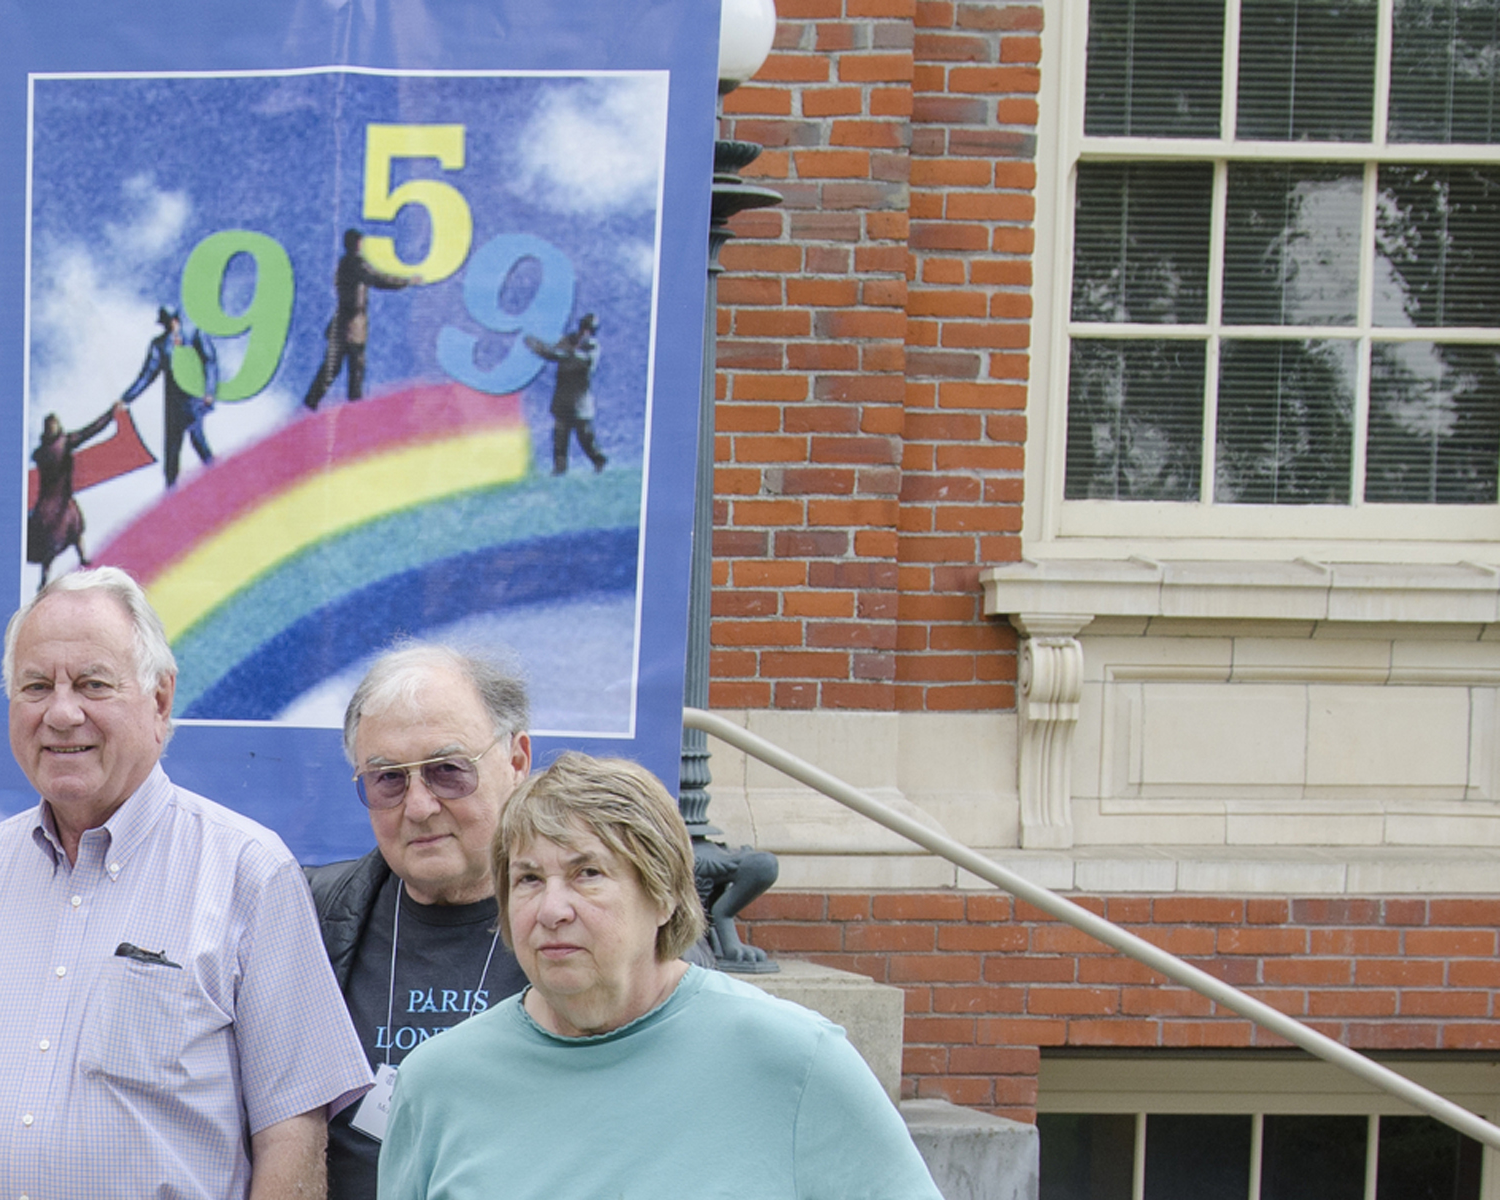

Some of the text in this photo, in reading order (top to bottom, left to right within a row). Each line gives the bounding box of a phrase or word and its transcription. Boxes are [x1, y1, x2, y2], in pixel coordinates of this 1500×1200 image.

[170, 124, 574, 402] 9 5 9
[406, 987, 489, 1013] PARIS
[374, 1026, 451, 1050] LON
